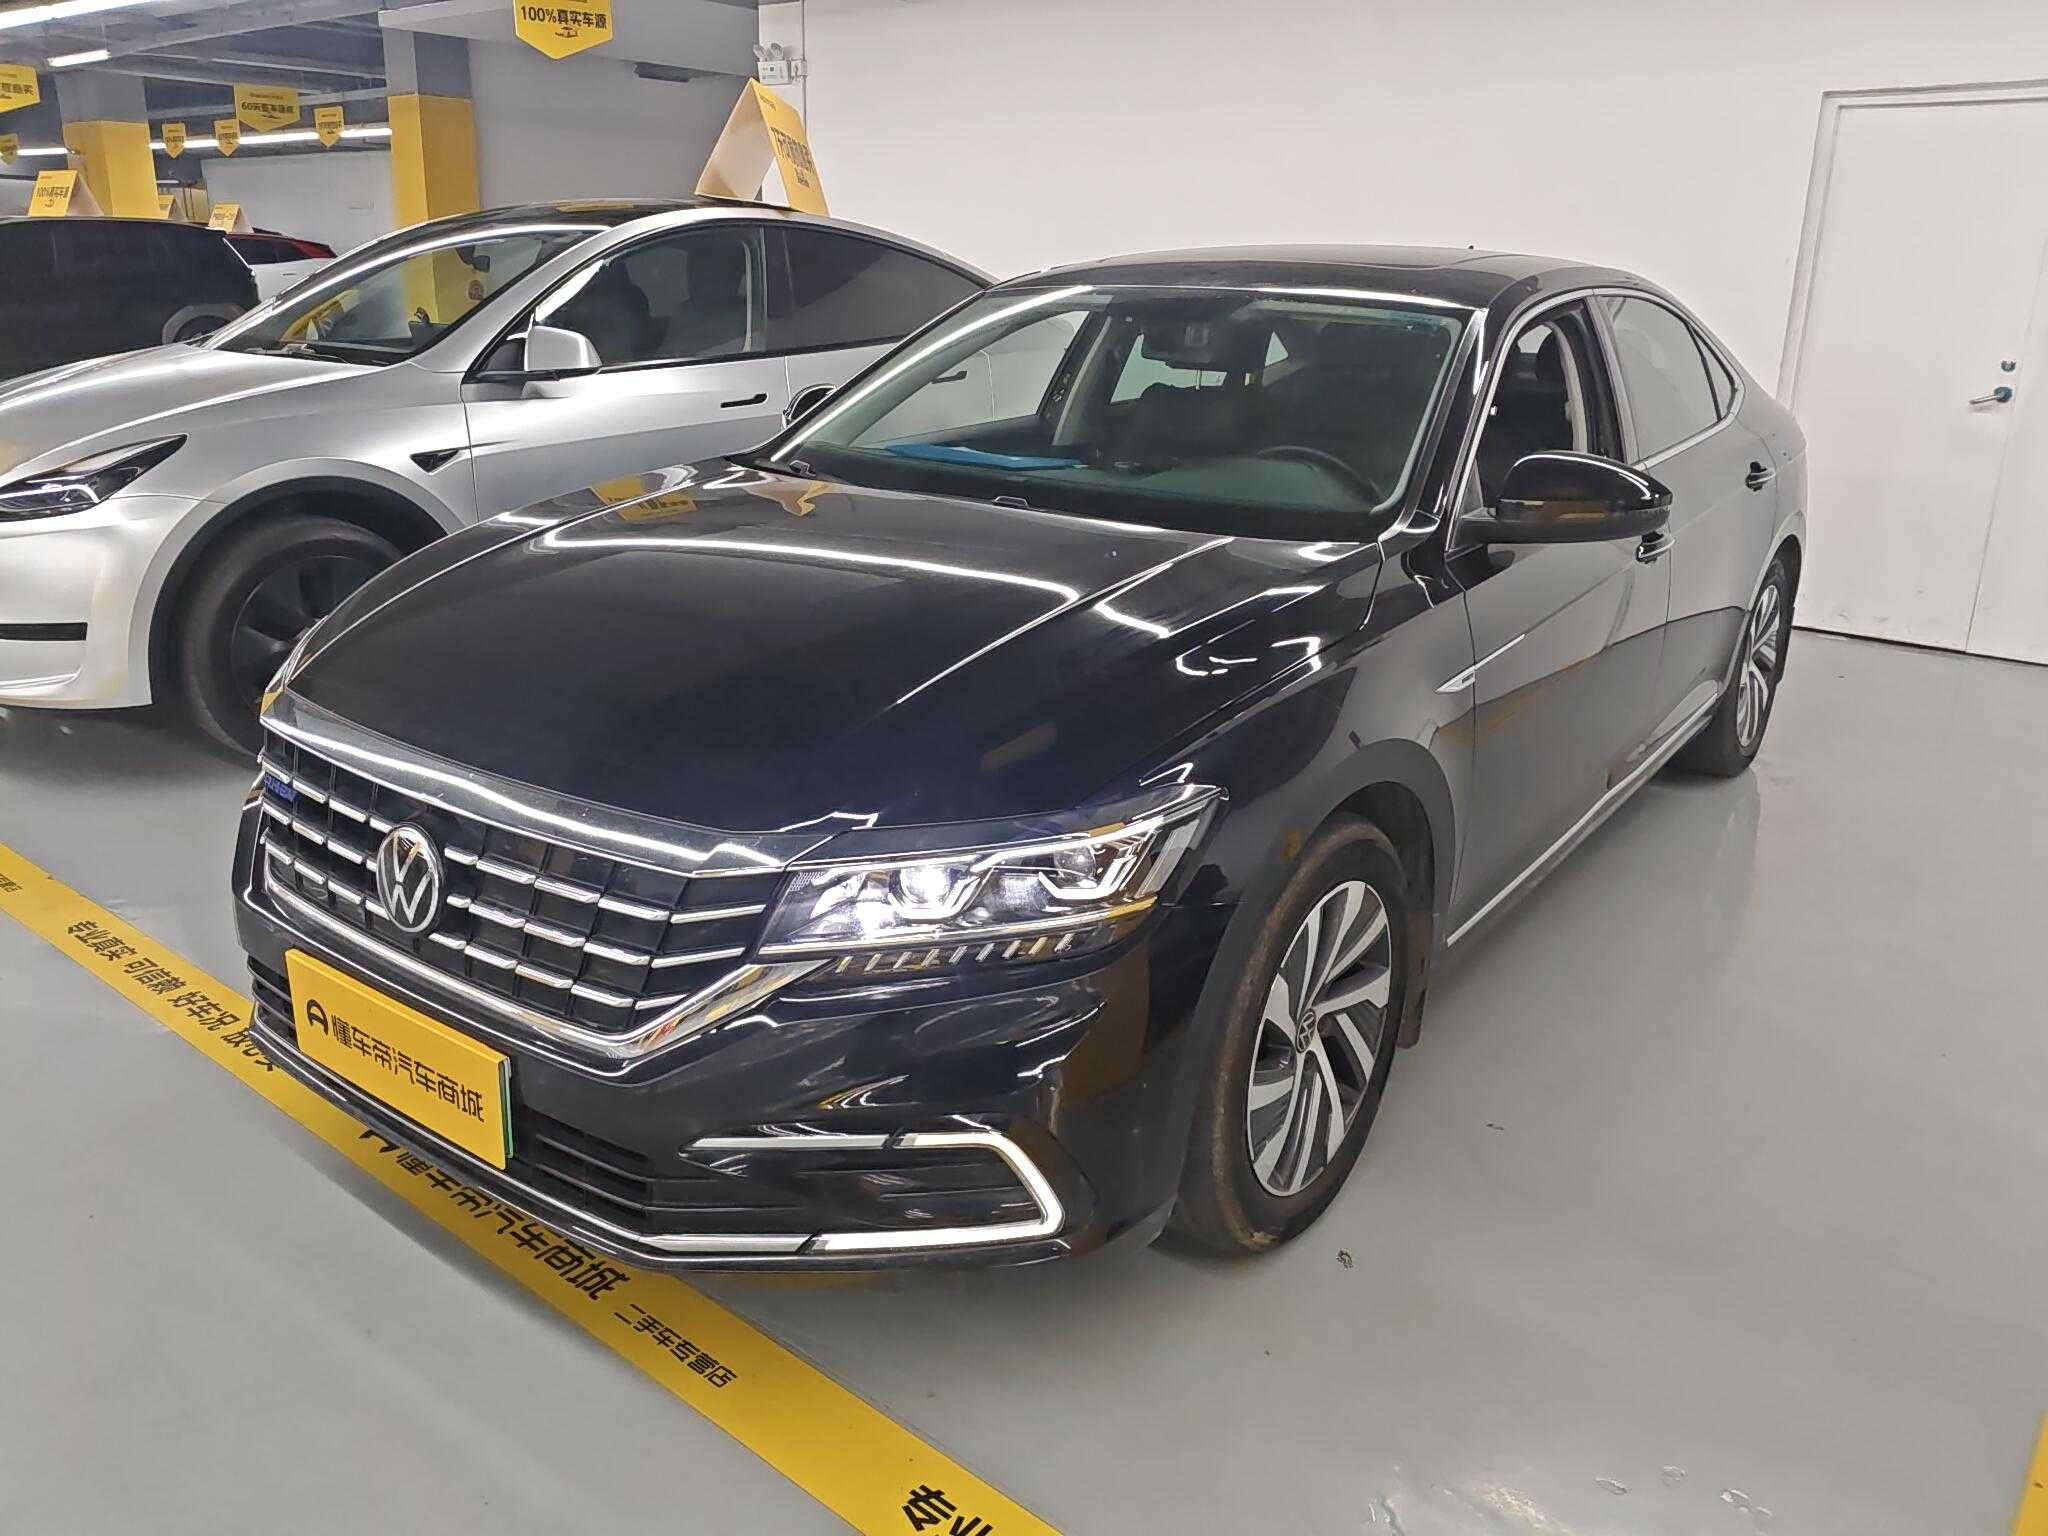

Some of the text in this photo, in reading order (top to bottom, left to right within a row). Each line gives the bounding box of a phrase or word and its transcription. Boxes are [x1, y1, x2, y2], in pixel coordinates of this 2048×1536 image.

[520, 6, 607, 29] 100%真实车源
[67, 920, 138, 961] 专业真实
[123, 957, 187, 995] 可信赖
[167, 990, 242, 1032] 好车况
[331, 1014, 485, 1123] 懂车帝汽车商城
[613, 1303, 738, 1389] 二手车专营店
